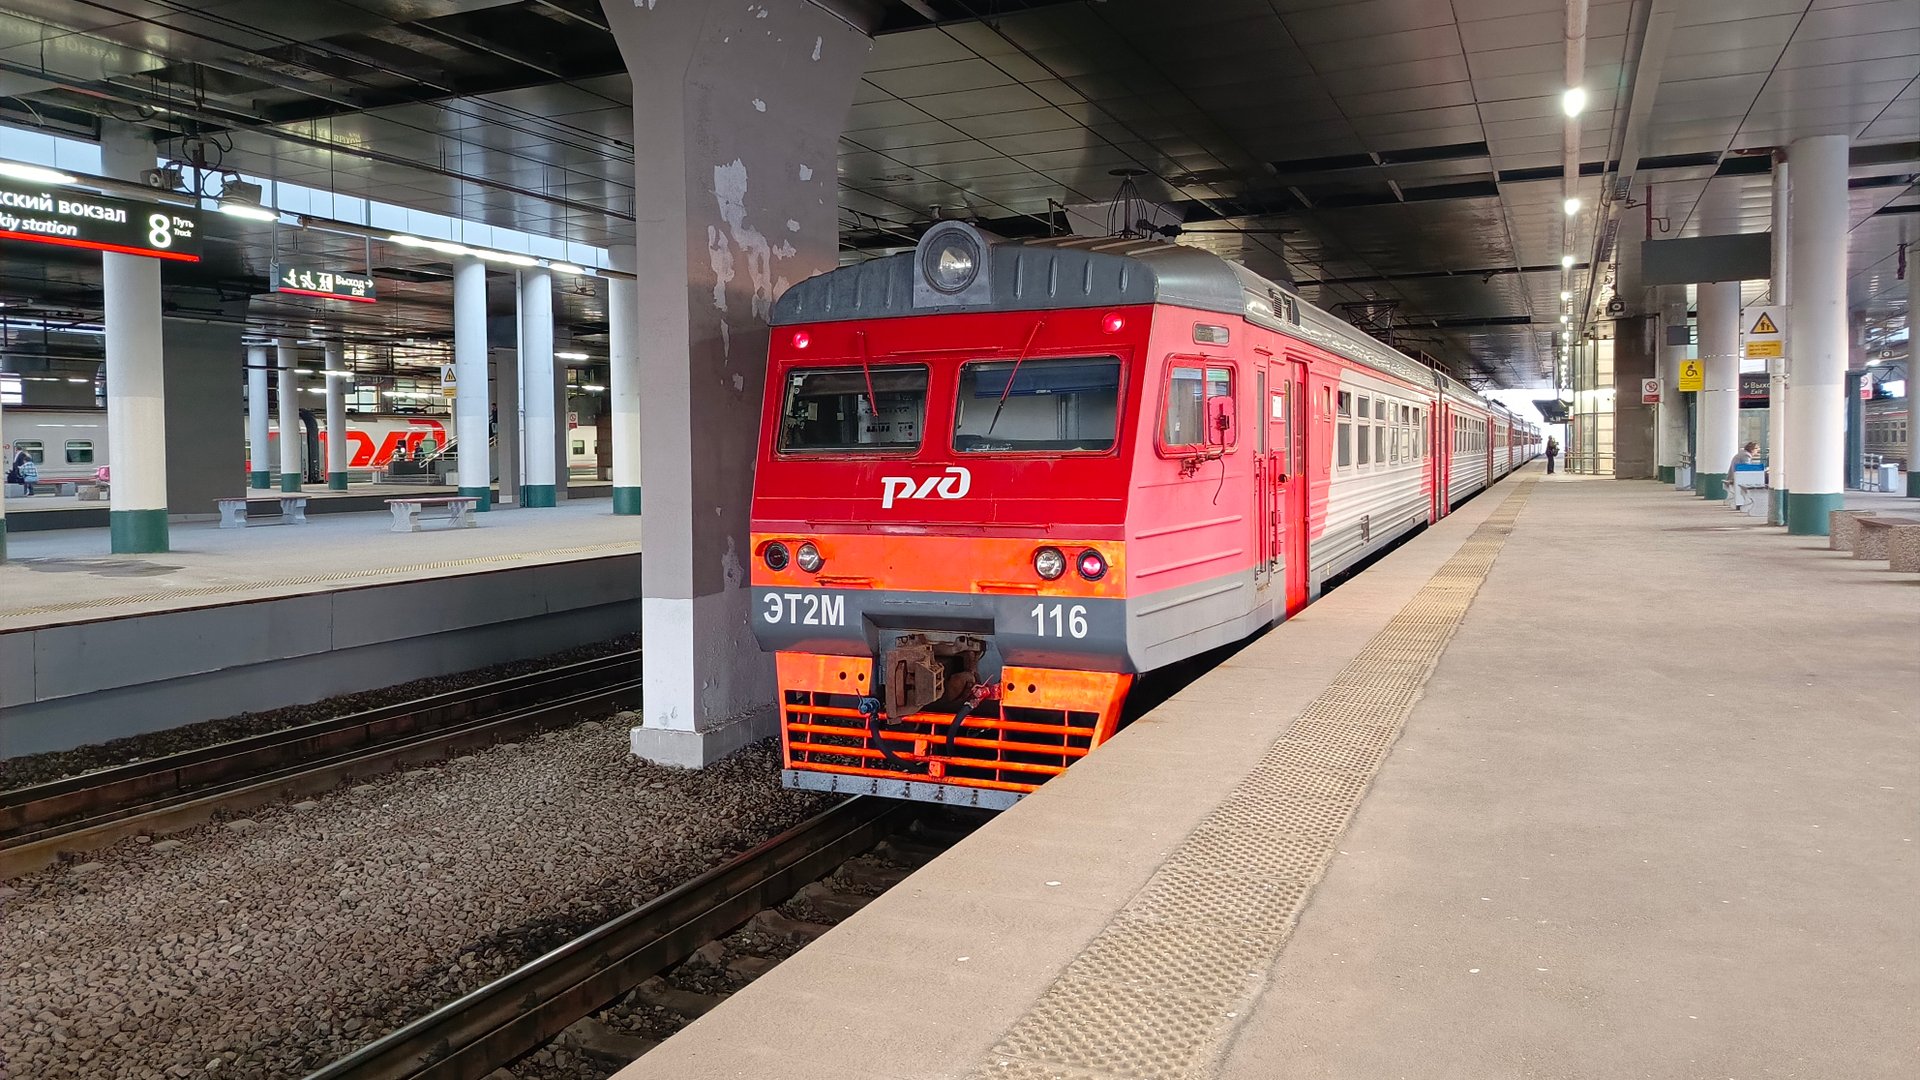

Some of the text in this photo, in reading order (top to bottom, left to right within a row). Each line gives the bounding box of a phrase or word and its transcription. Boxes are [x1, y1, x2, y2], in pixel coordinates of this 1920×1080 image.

[58, 199, 127, 224] вокзал
[173, 216, 195, 228] Путь
[22, 217, 78, 237] station
[149, 213, 172, 249] 8
[174, 227, 192, 238] Track
[335, 274, 365, 290] Выход
[763, 592, 845, 626] ЭТ2М
[1031, 603, 1088, 639] 116
